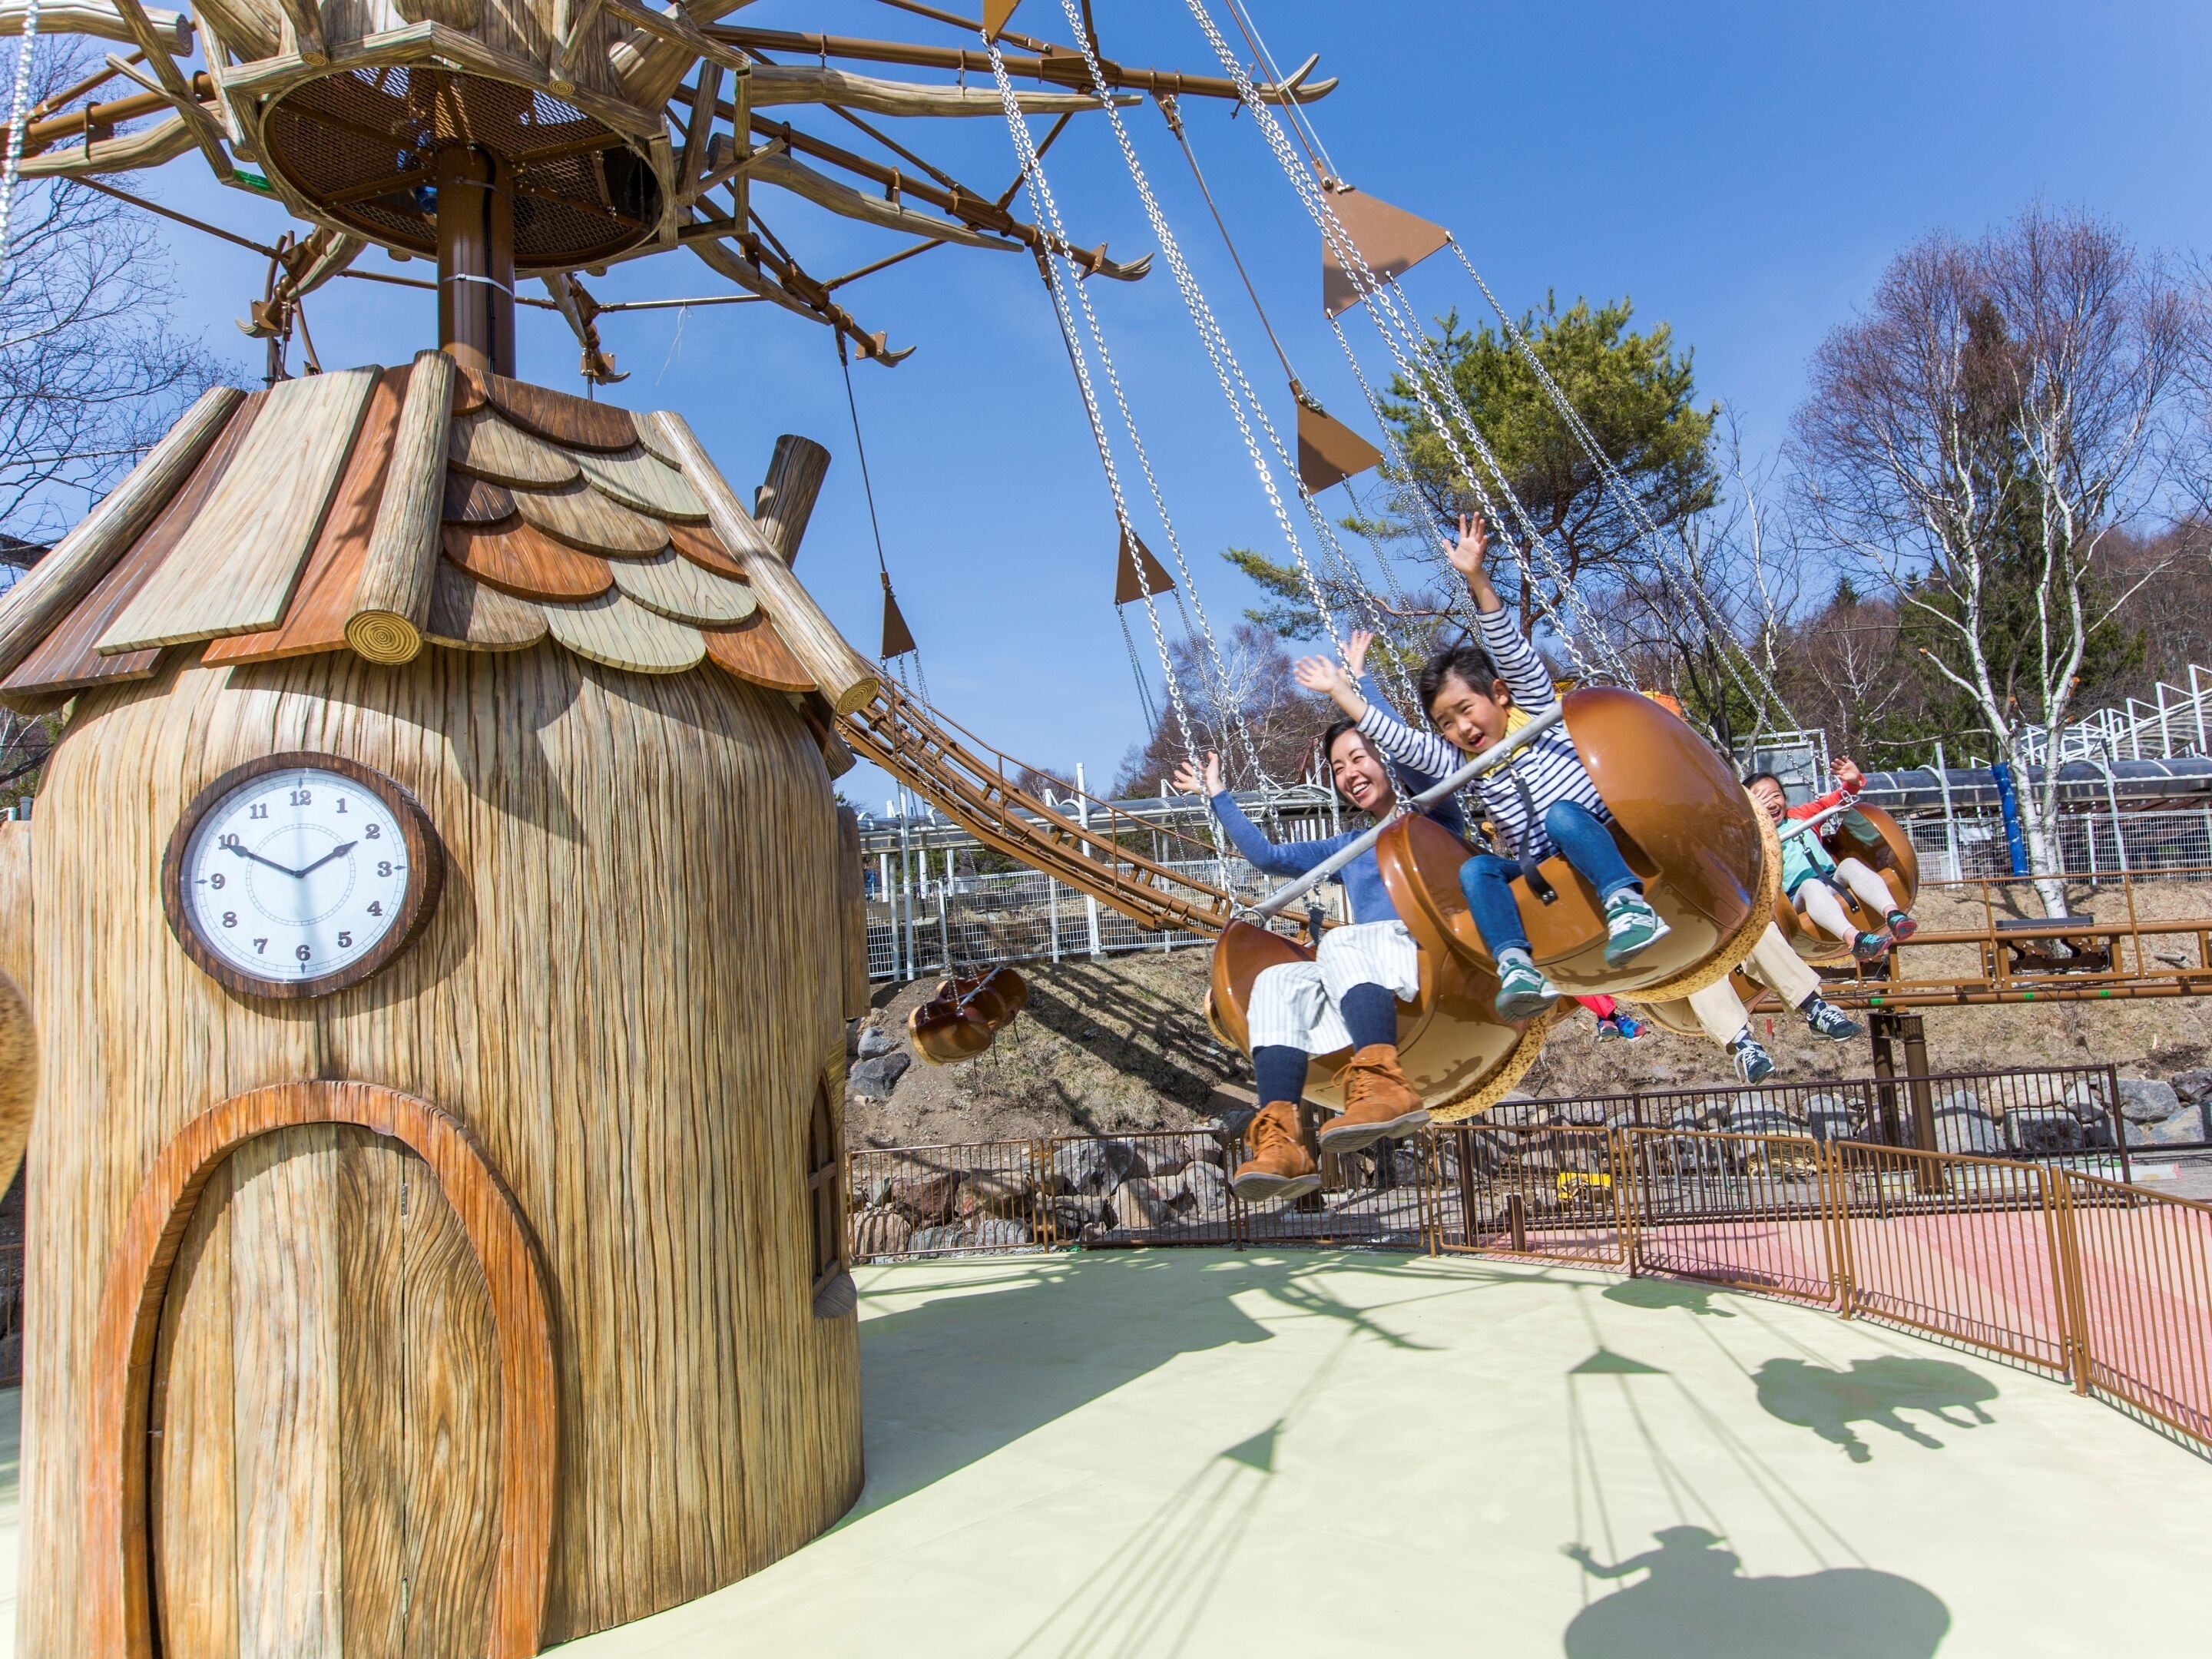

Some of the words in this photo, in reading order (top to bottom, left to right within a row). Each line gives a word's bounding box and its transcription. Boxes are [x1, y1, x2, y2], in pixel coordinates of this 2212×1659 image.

[290, 790, 311, 805] 12
[336, 798, 347, 813] 1
[250, 803, 268, 819] 11
[366, 823, 380, 839] 2
[219, 833, 240, 849] 10
[378, 860, 392, 877] 3
[211, 873, 225, 889] 9
[367, 900, 382, 916] 4
[223, 912, 237, 928] 8
[253, 938, 267, 954] 7
[338, 931, 352, 947] 5
[296, 944, 310, 961] 6
